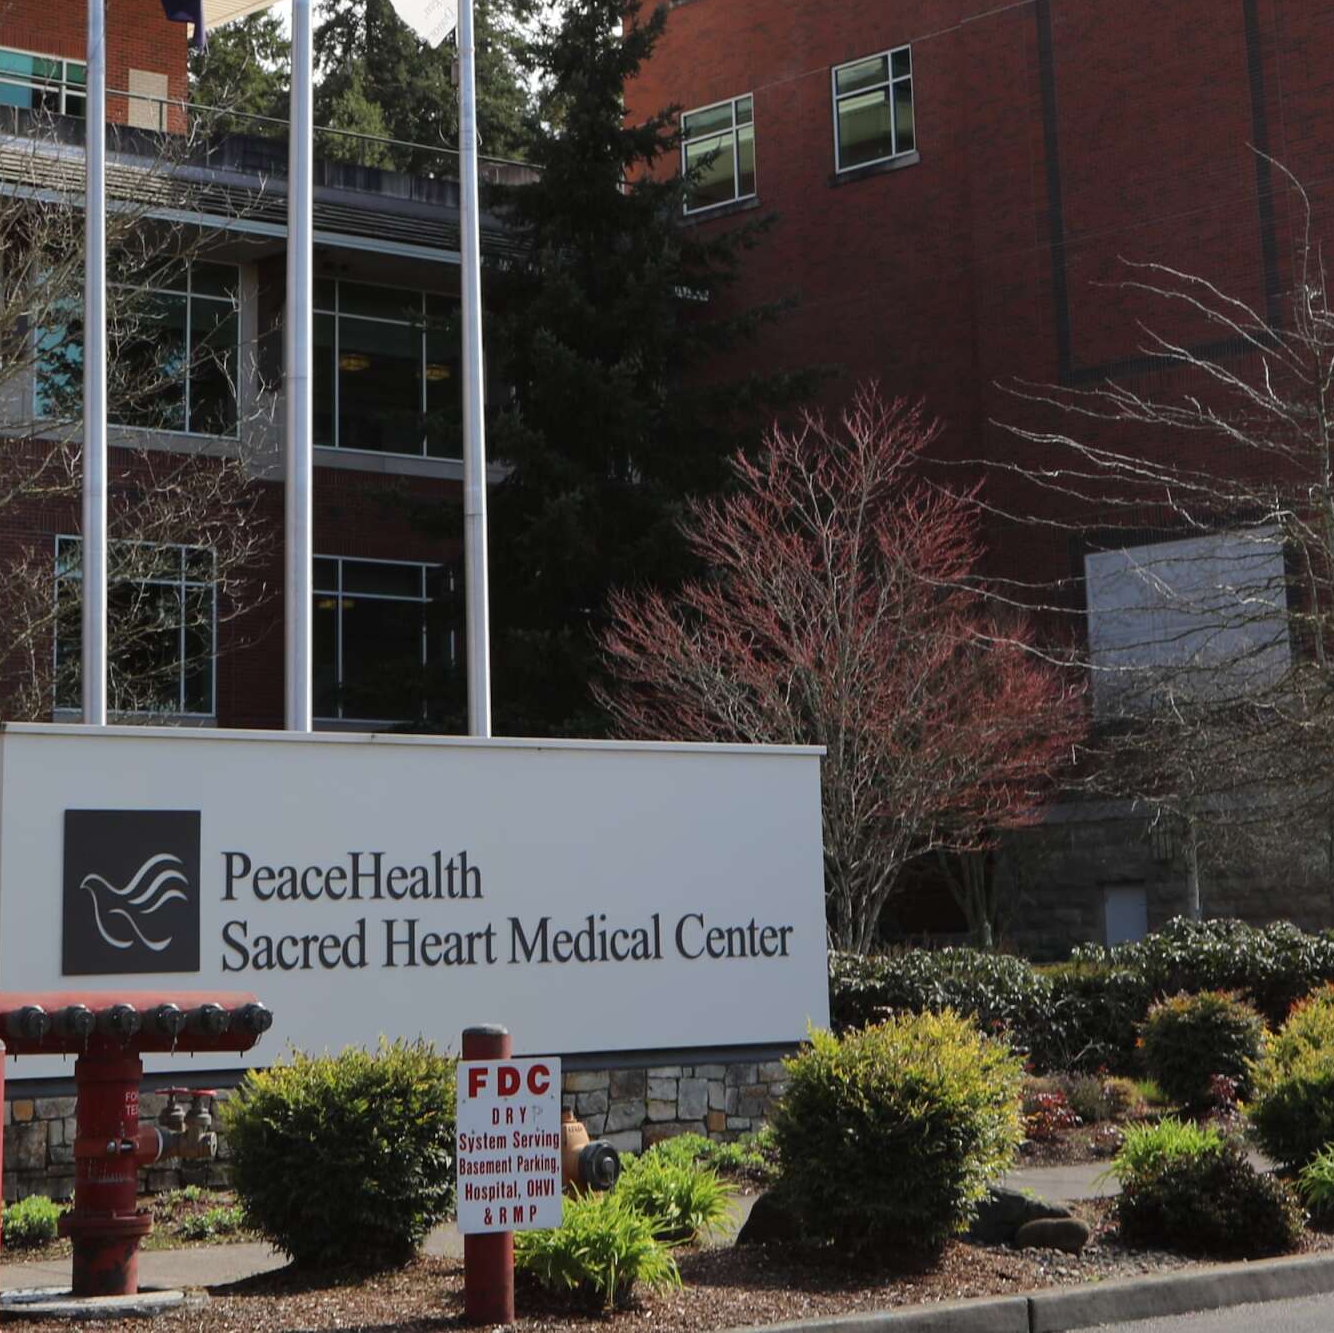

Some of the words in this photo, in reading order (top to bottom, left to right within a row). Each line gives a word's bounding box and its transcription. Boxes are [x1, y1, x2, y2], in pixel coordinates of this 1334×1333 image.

[221, 850, 483, 901] PeaceHealth
[222, 917, 369, 972] Sacred
[382, 919, 498, 968] Heart
[507, 913, 663, 964] Medical
[674, 913, 794, 960] Center
[468, 1064, 550, 1098] FDC
[492, 1107, 527, 1126] DRY
[459, 1132, 507, 1153] System
[513, 1129, 560, 1149] Serving
[459, 1156, 512, 1176] Basement
[465, 1182, 521, 1203] Hospital,
[527, 1179, 555, 1197] OHVI
[483, 1207, 493, 1226] &
[499, 1205, 537, 1225] RMP
